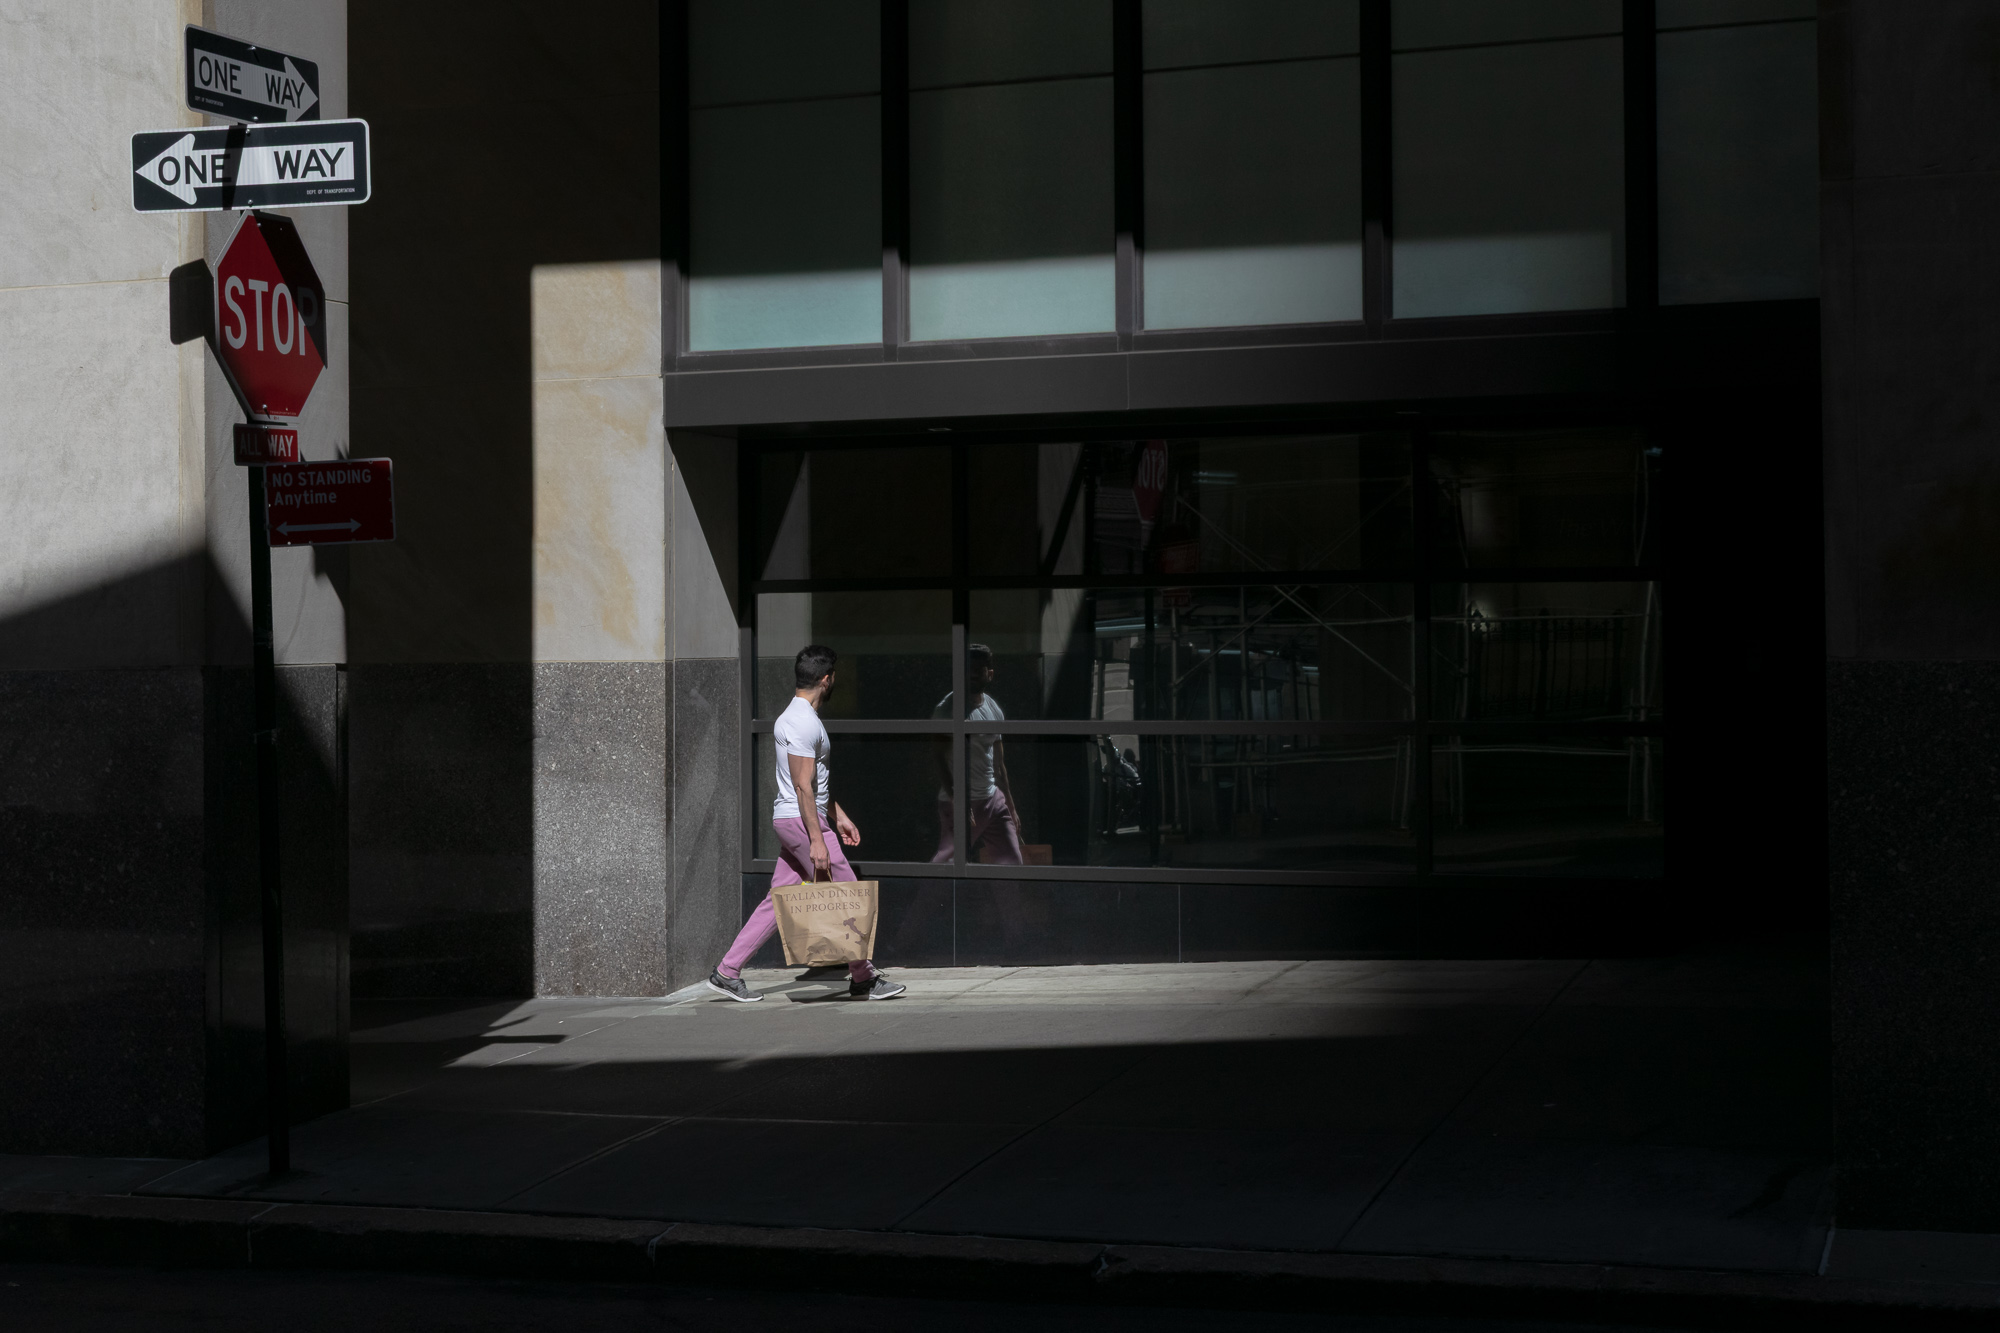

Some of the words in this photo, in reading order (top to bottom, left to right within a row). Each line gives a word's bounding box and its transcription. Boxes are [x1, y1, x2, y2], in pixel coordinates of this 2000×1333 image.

[199, 56, 242, 94] ONE
[265, 72, 306, 109] WAY
[158, 154, 232, 186] ONE
[273, 148, 345, 180] WAY
[224, 275, 319, 356] STOP
[239, 432, 262, 456] ALL
[267, 434, 294, 457] WAY
[272, 472, 293, 488] NO
[297, 469, 372, 487] STANDING
[274, 489, 337, 509] Anytime
[829, 889, 870, 898] DINNER
[790, 905, 802, 914] IN
[806, 902, 860, 912] PROGRESS
